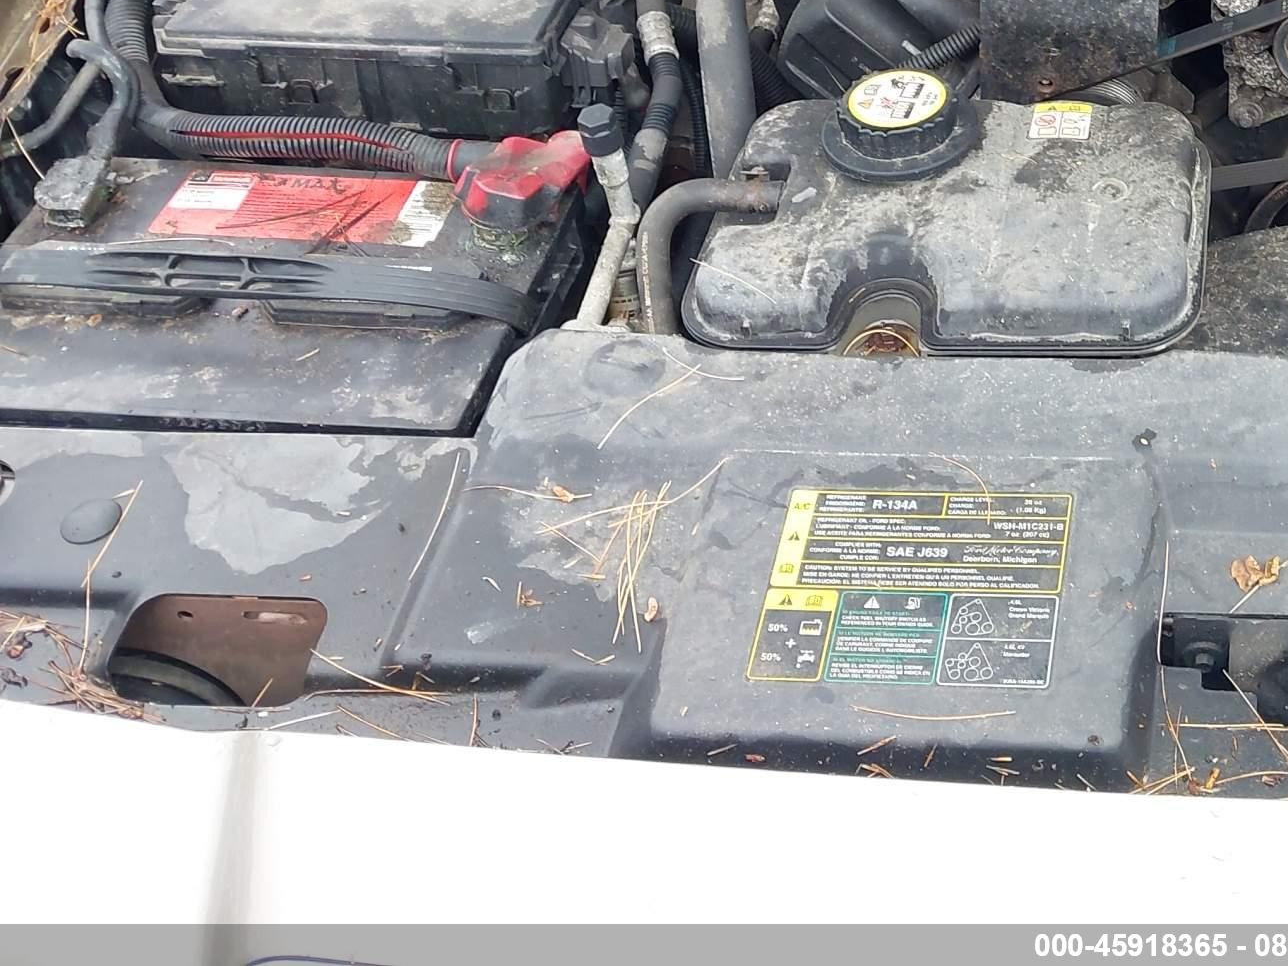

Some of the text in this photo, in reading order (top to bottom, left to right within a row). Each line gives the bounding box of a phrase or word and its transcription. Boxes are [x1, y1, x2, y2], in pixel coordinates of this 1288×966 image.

[872, 499, 917, 511] R-134A
[886, 547, 948, 558] SAE J639
[963, 555, 1000, 563] Dearborn,
[767, 623, 788, 632] 50%
[760, 652, 781, 662] 50%
